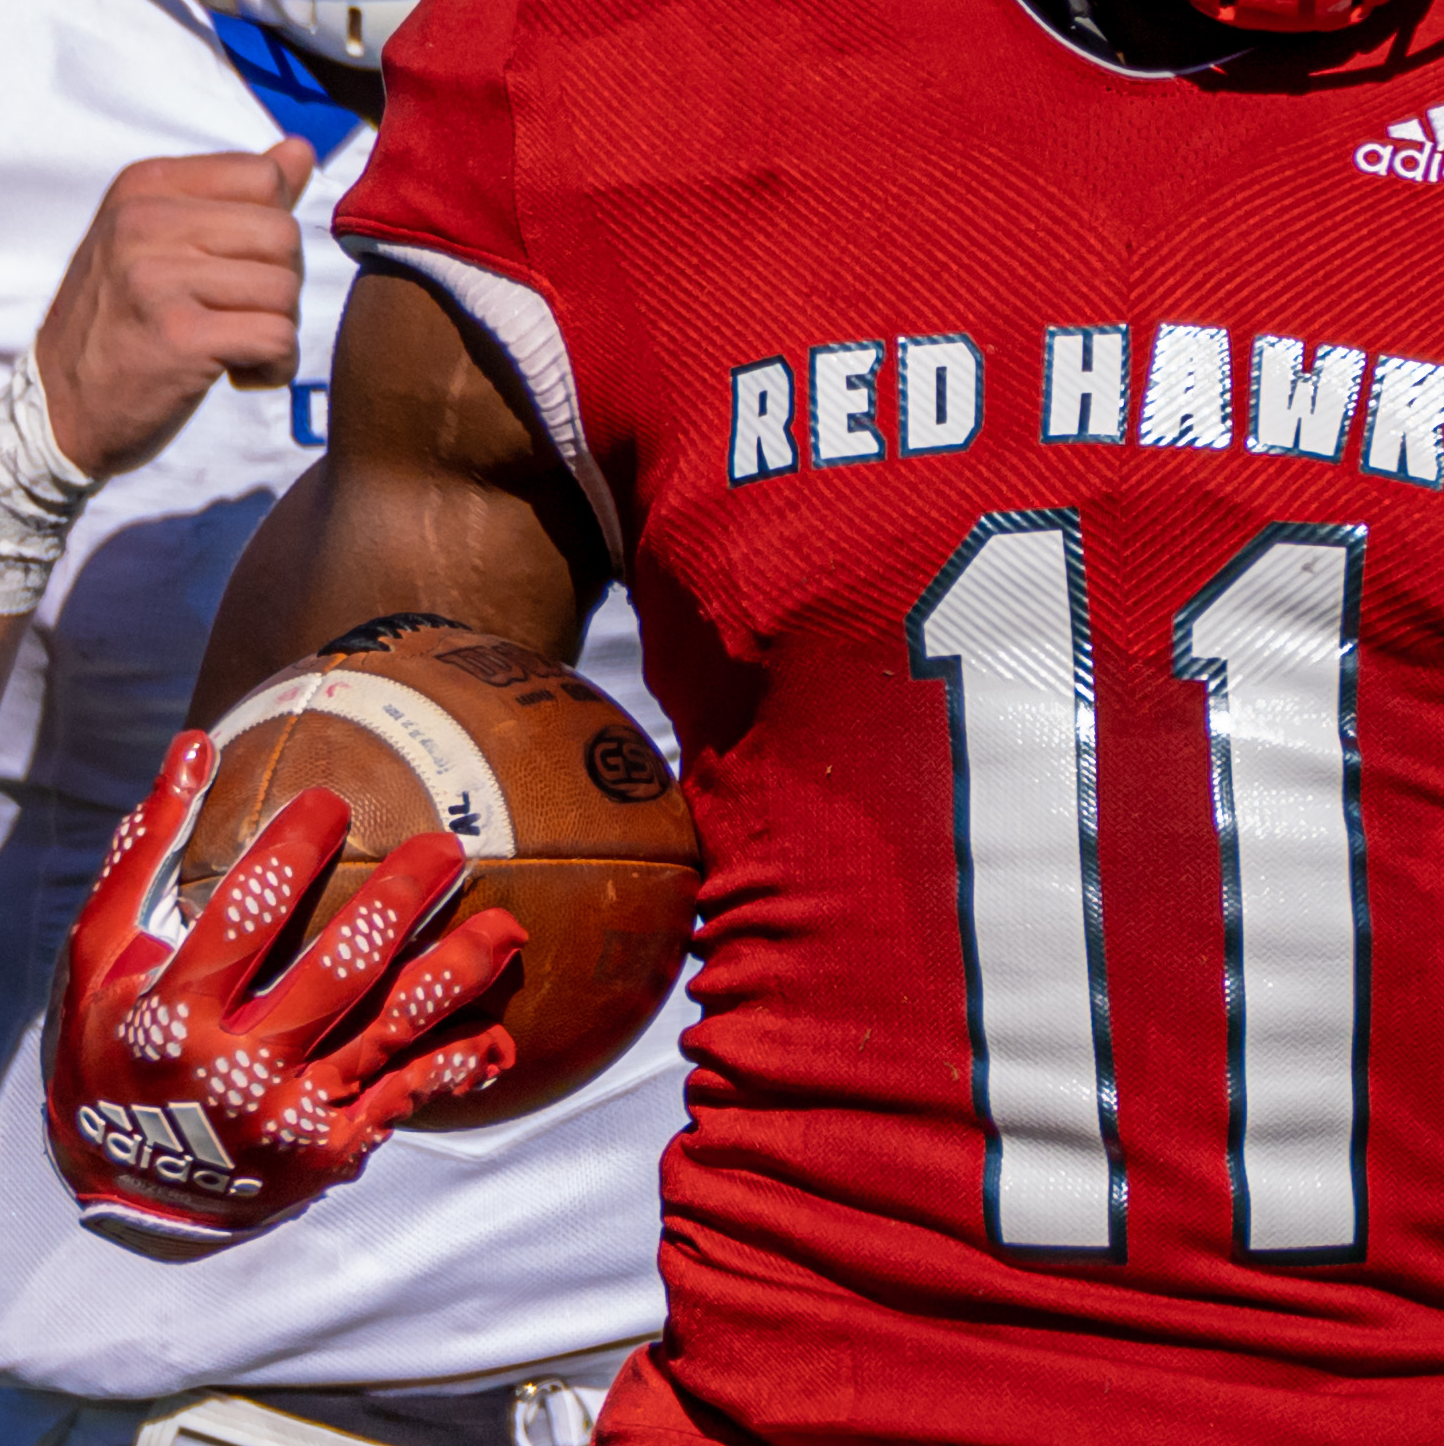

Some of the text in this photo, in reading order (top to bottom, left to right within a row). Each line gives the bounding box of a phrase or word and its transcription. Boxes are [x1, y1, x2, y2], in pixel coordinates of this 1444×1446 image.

[728, 332, 985, 489] RED
[904, 506, 1371, 1266] 11
[78, 1105, 264, 1199] adidas
